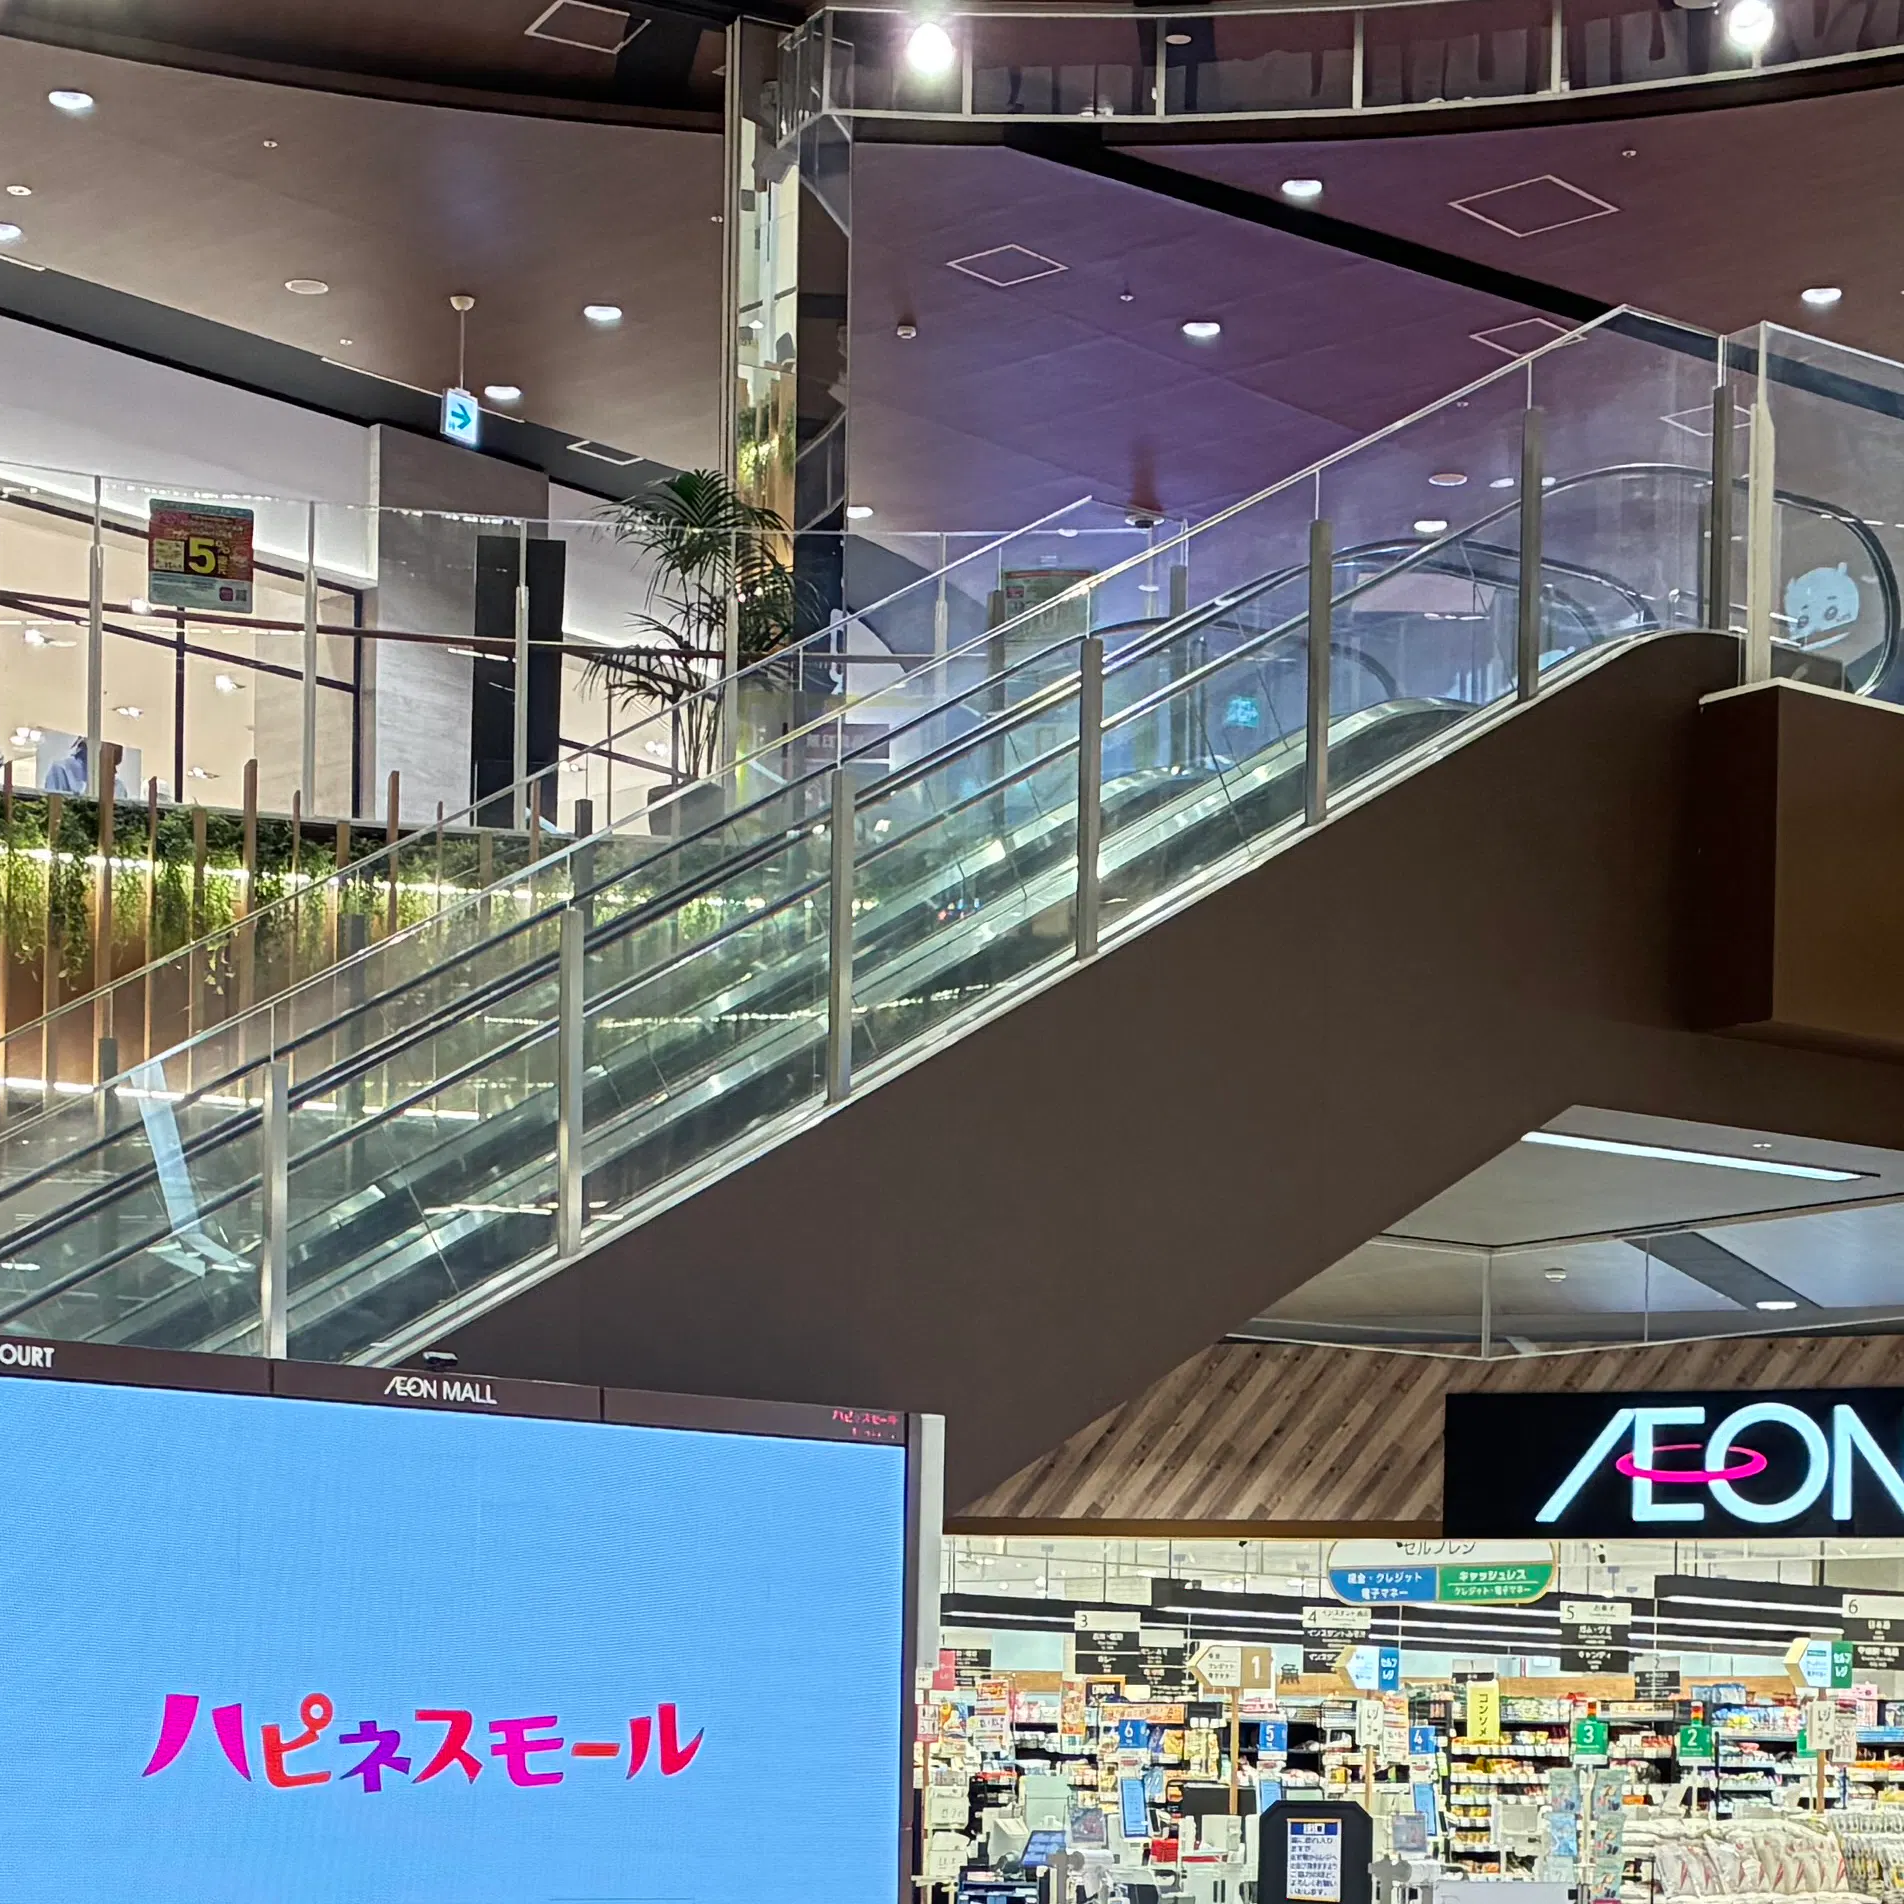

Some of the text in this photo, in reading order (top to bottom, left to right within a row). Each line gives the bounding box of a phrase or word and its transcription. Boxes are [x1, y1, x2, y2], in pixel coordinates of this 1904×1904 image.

[442, 1382, 498, 1405] MALL
[1347, 1571, 1423, 1584] 現金・クレジット
[1459, 1569, 1527, 1582] キャッシュレス
[1361, 1587, 1409, 1600] 電子マネー
[1566, 1605, 1575, 1620] 5
[1848, 1599, 1859, 1614] 6
[1080, 1615, 1088, 1628] 3
[1307, 1610, 1317, 1623] 4
[1252, 1655, 1262, 1680] 1
[1478, 1693, 1489, 1738] コンソメ
[1124, 1721, 1133, 1737] 6
[1265, 1725, 1275, 1742] 5
[1583, 1725, 1595, 1744] 3
[140, 1691, 704, 1793] ハピネスモール
[1687, 1729, 1698, 1746] 2
